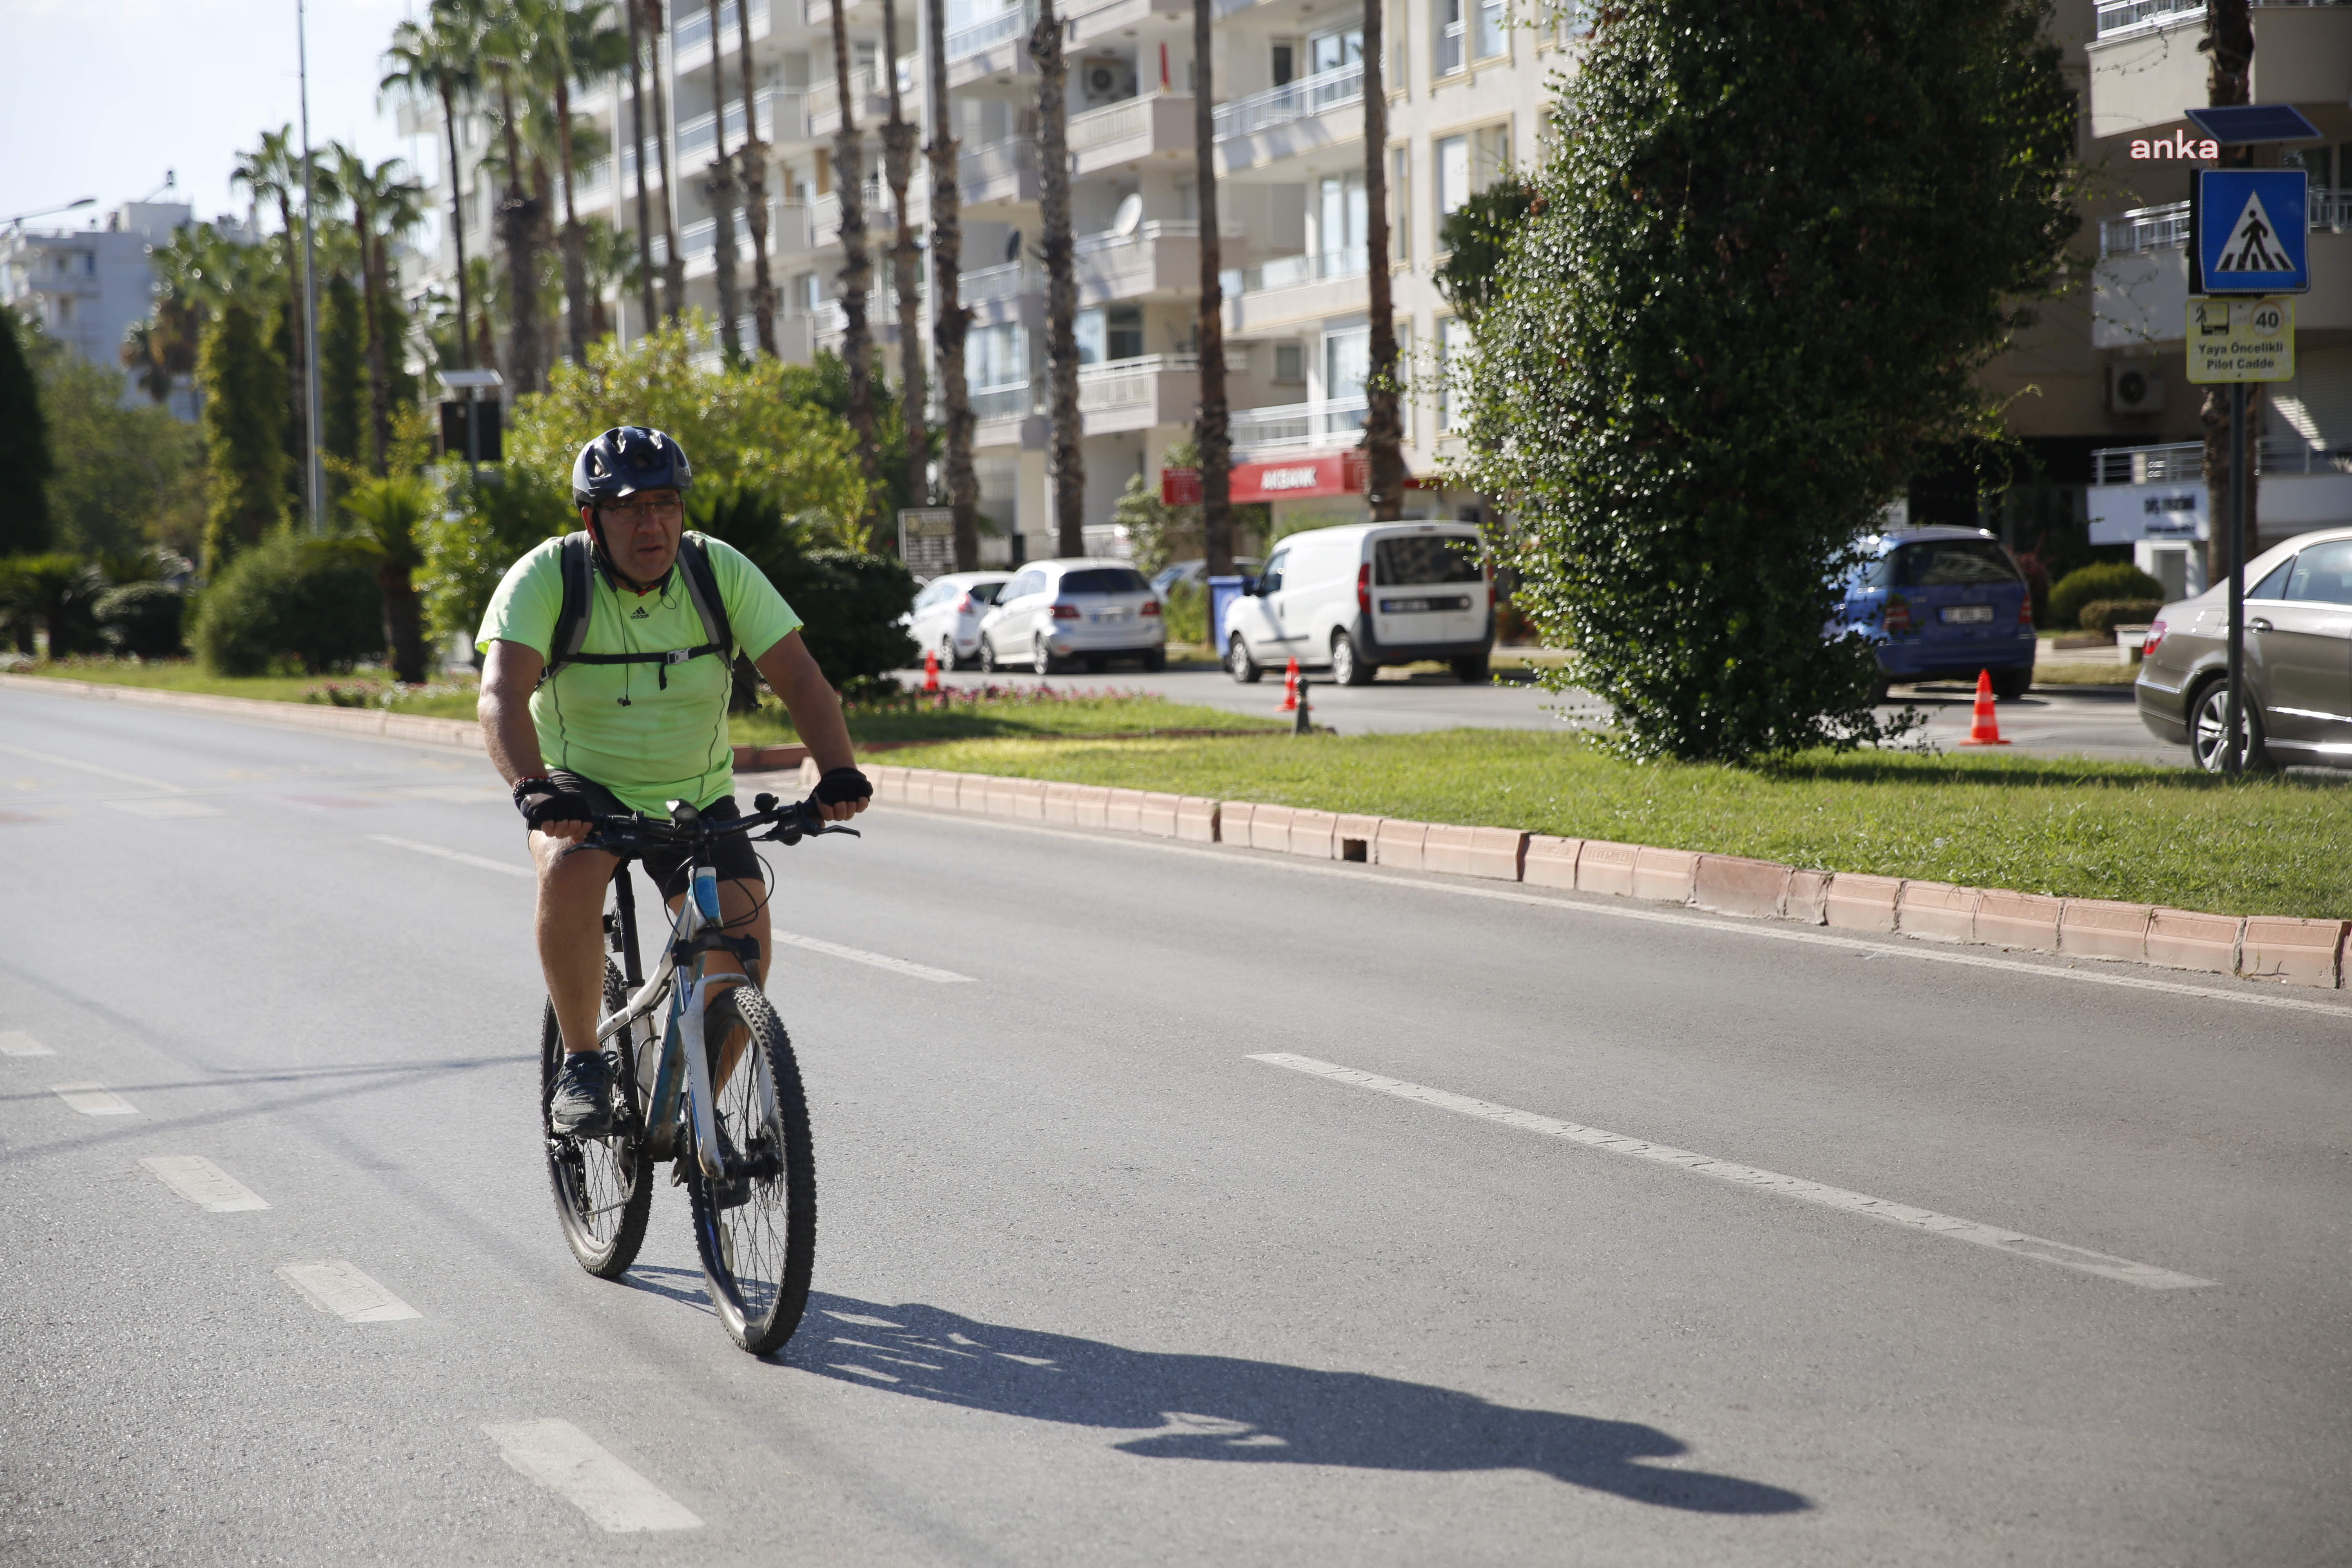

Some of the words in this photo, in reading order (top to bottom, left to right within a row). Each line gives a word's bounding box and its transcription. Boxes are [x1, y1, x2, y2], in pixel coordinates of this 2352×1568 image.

[2256, 311, 2279, 329] 40
[2198, 343, 2227, 358] Yaya
[2231, 342, 2284, 354] Öncelikli
[2207, 359, 2234, 370] Pilot
[2237, 357, 2274, 370] Cadde
[1261, 466, 1317, 490] AKBANK
[733, 821, 753, 831] GHOST
